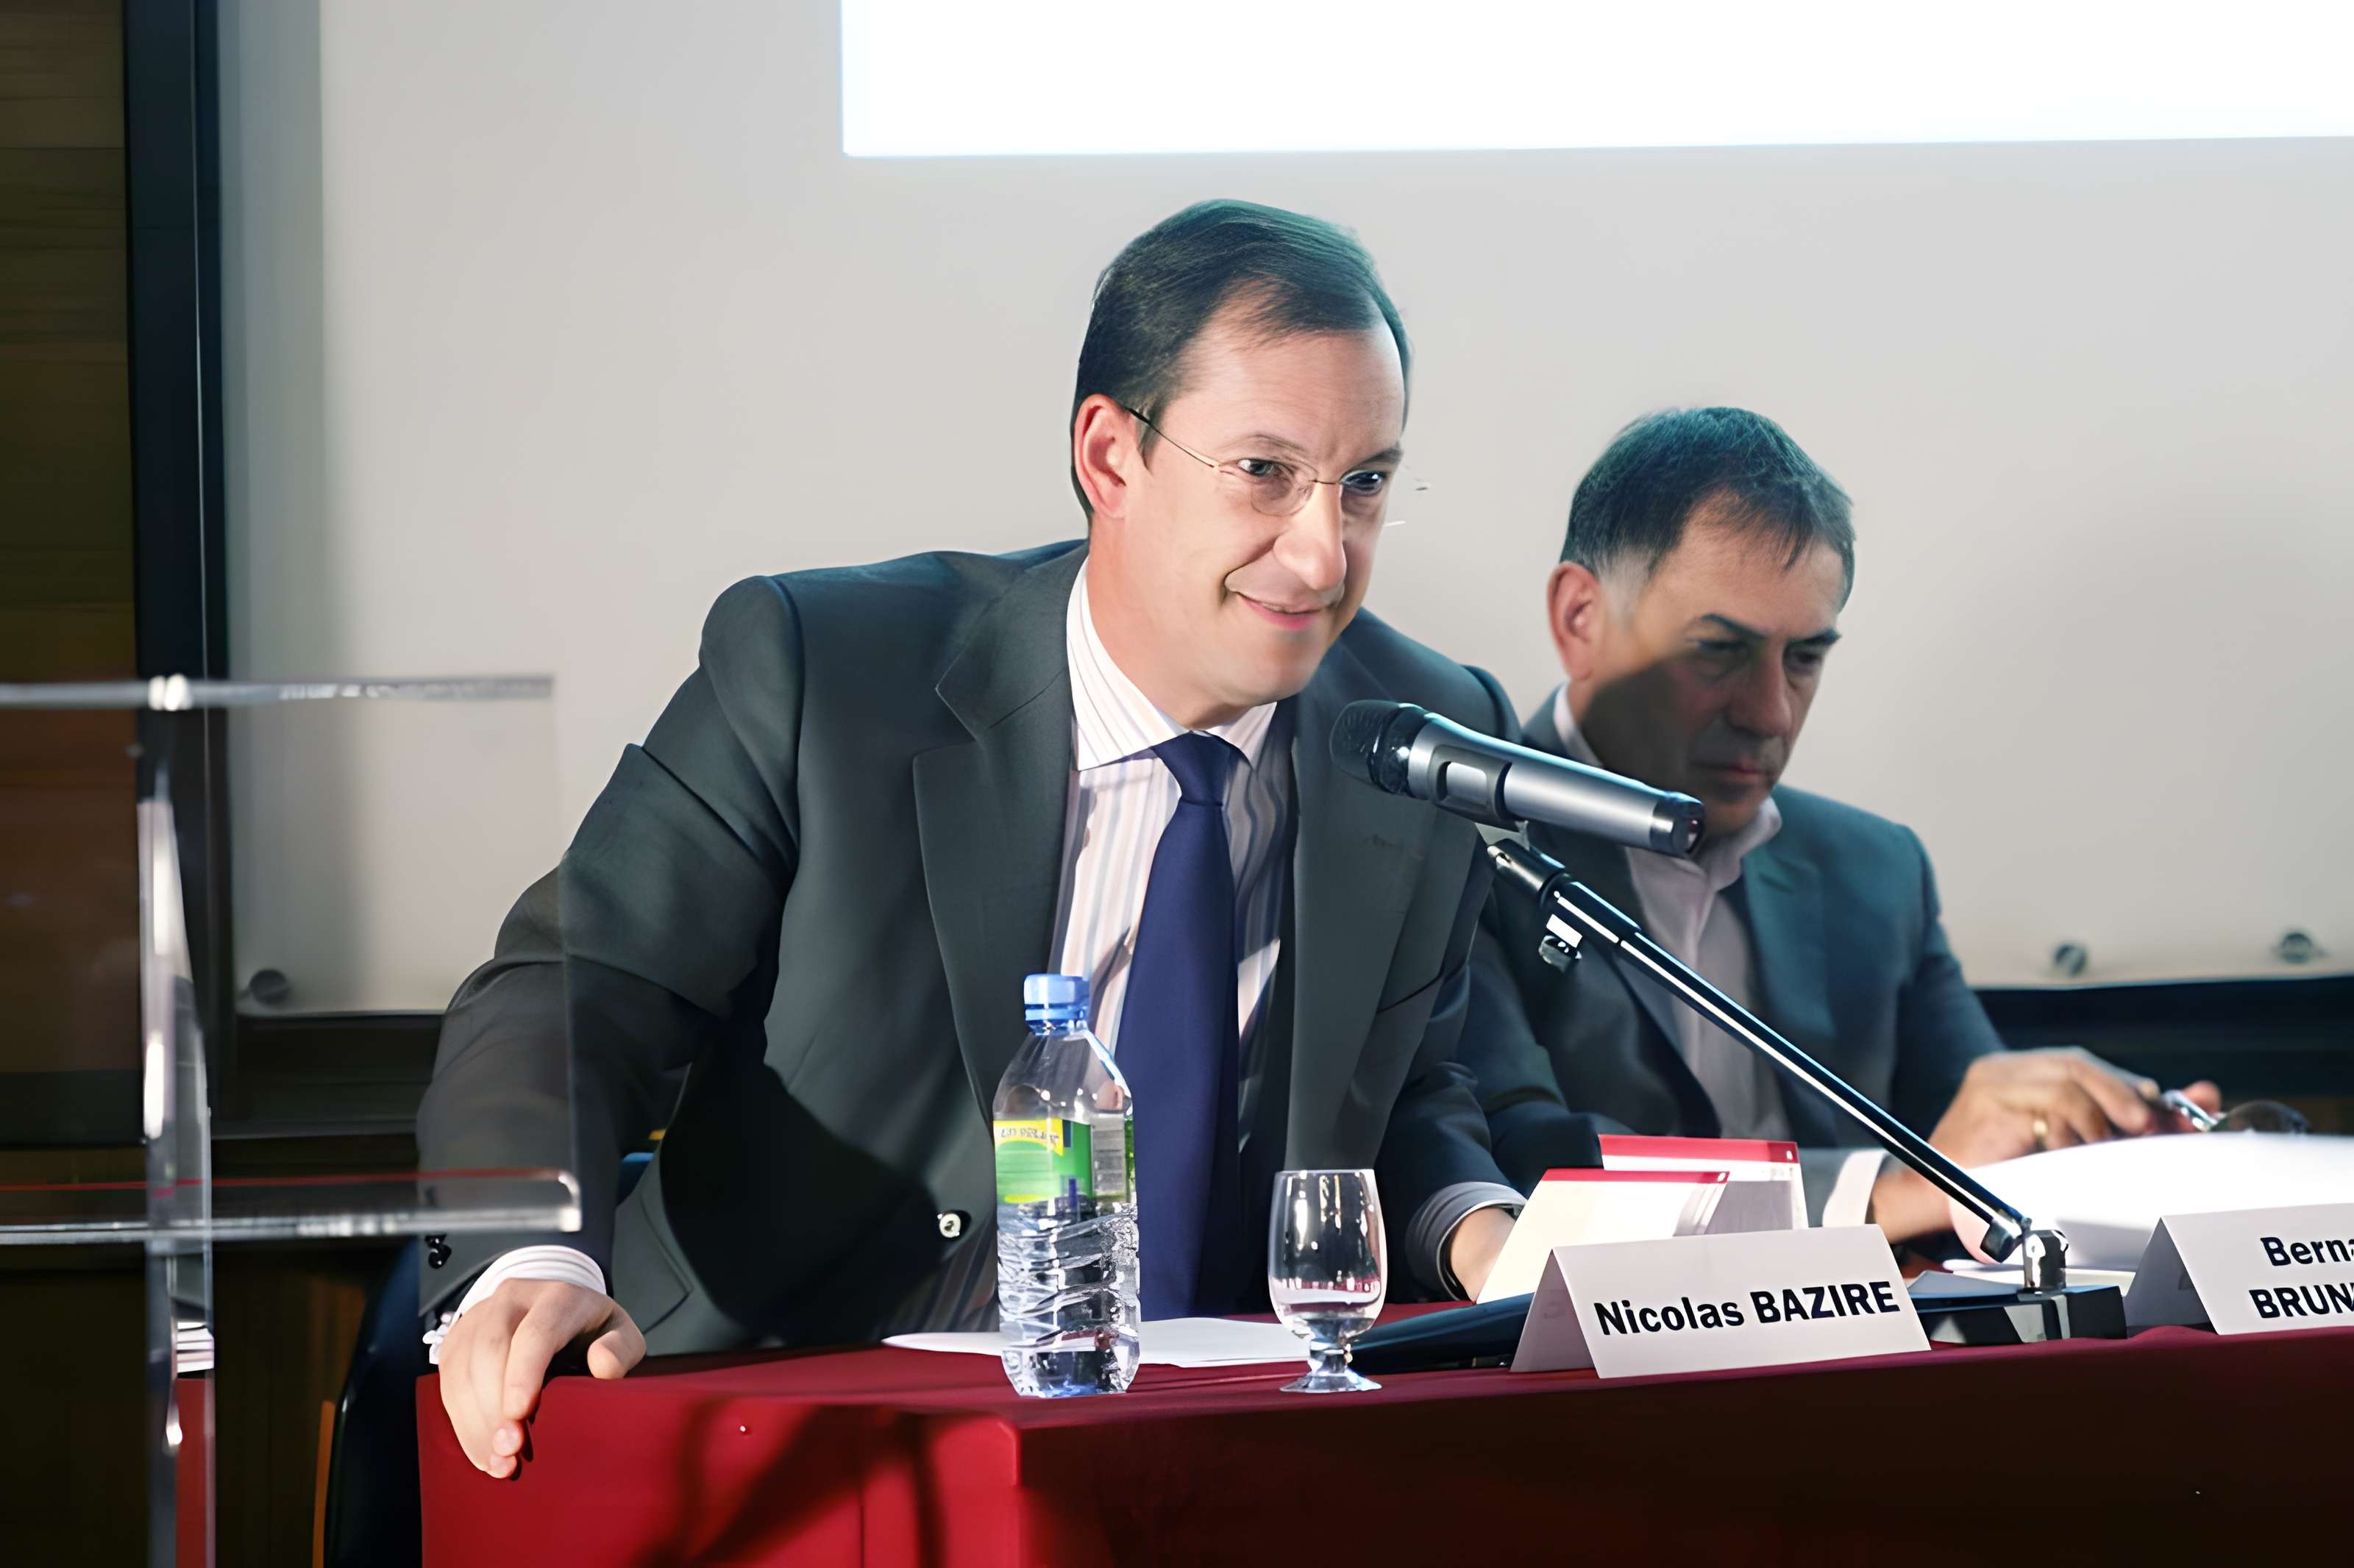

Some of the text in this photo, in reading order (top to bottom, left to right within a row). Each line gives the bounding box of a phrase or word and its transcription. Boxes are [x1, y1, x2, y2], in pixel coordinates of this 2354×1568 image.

[2260, 1236, 2354, 1266] Bern
[1593, 1280, 1901, 1336] Nicolas BAZIRE
[2248, 1282, 2354, 1319] BRUN
